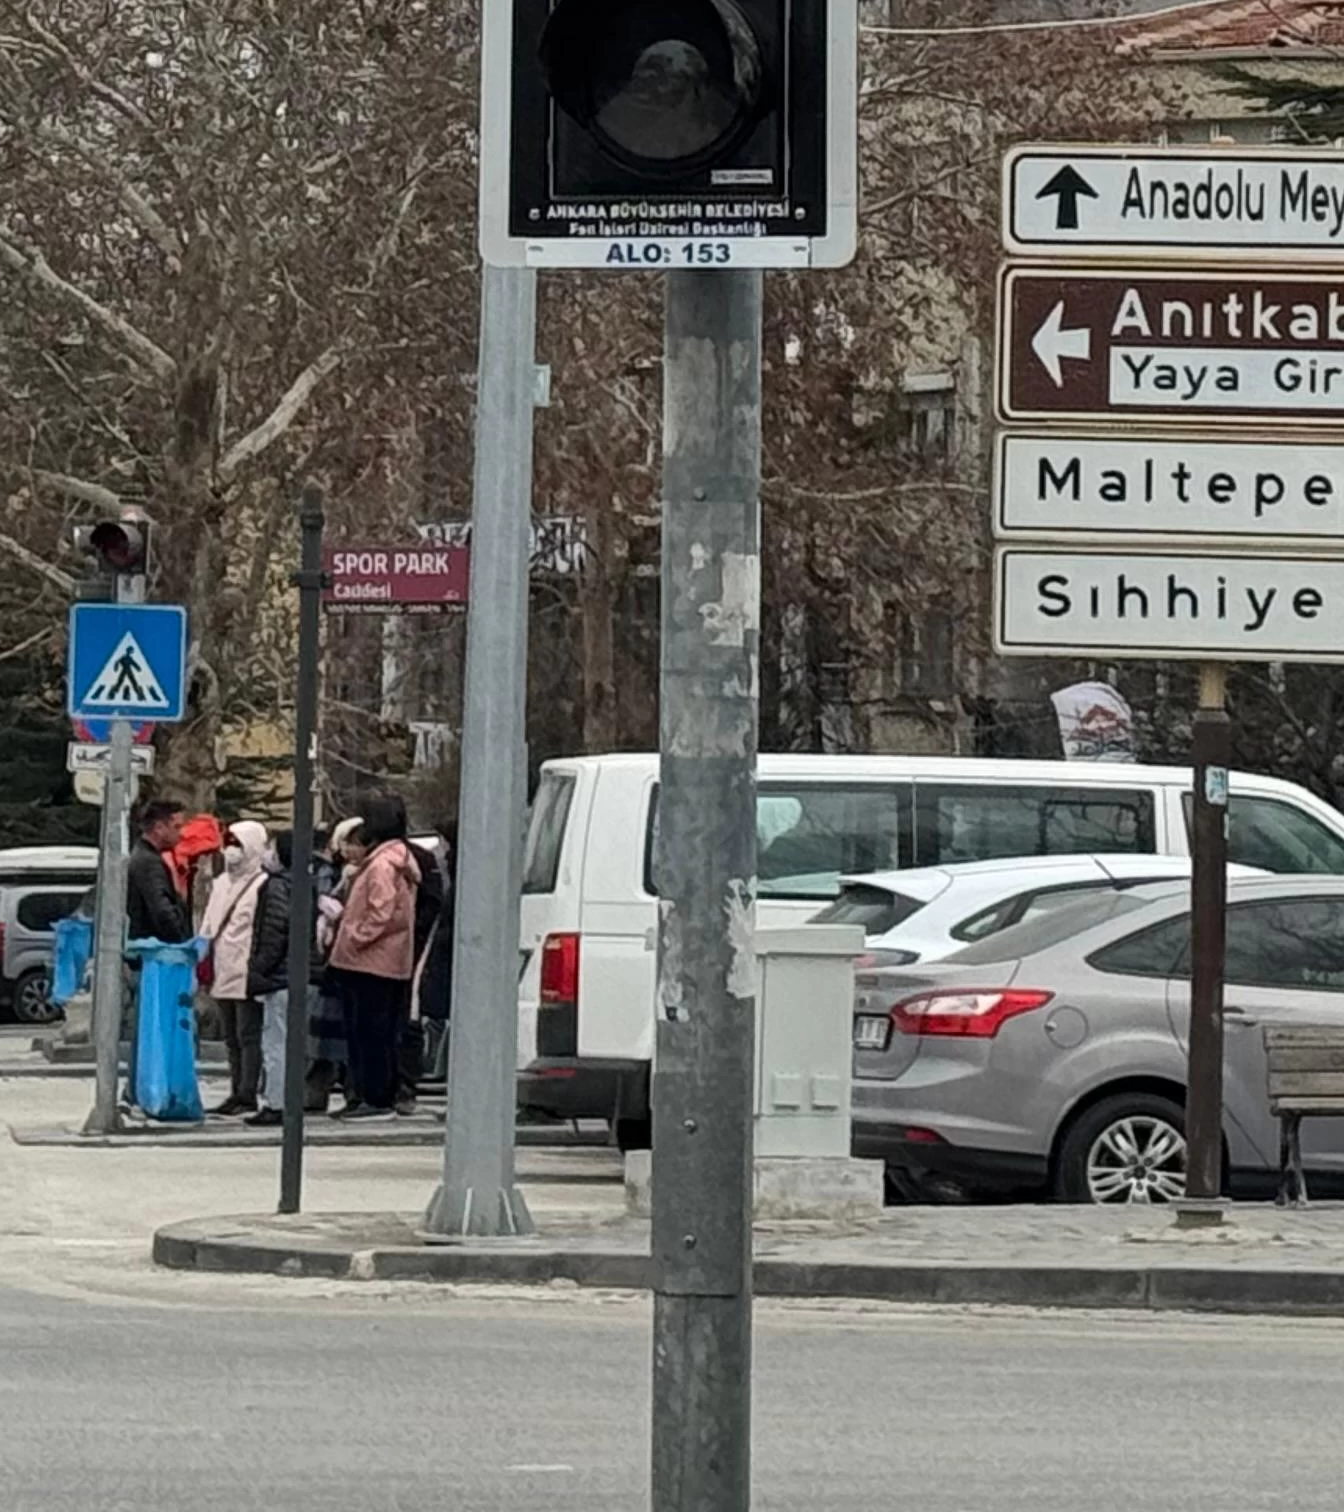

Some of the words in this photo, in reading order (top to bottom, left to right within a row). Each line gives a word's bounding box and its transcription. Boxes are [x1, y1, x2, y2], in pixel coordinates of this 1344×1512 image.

[546, 203, 609, 220] ANKARA
[1120, 165, 1265, 223] Anadolu
[605, 242, 672, 264] ALO:
[681, 242, 732, 263] 153
[1121, 353, 1240, 402] Yaya
[1037, 456, 1335, 518] Maltepe
[332, 552, 389, 576] SPOR
[393, 552, 450, 576] PARK
[332, 581, 392, 601] Caddesi
[1037, 573, 1325, 633] Sıhhiye
